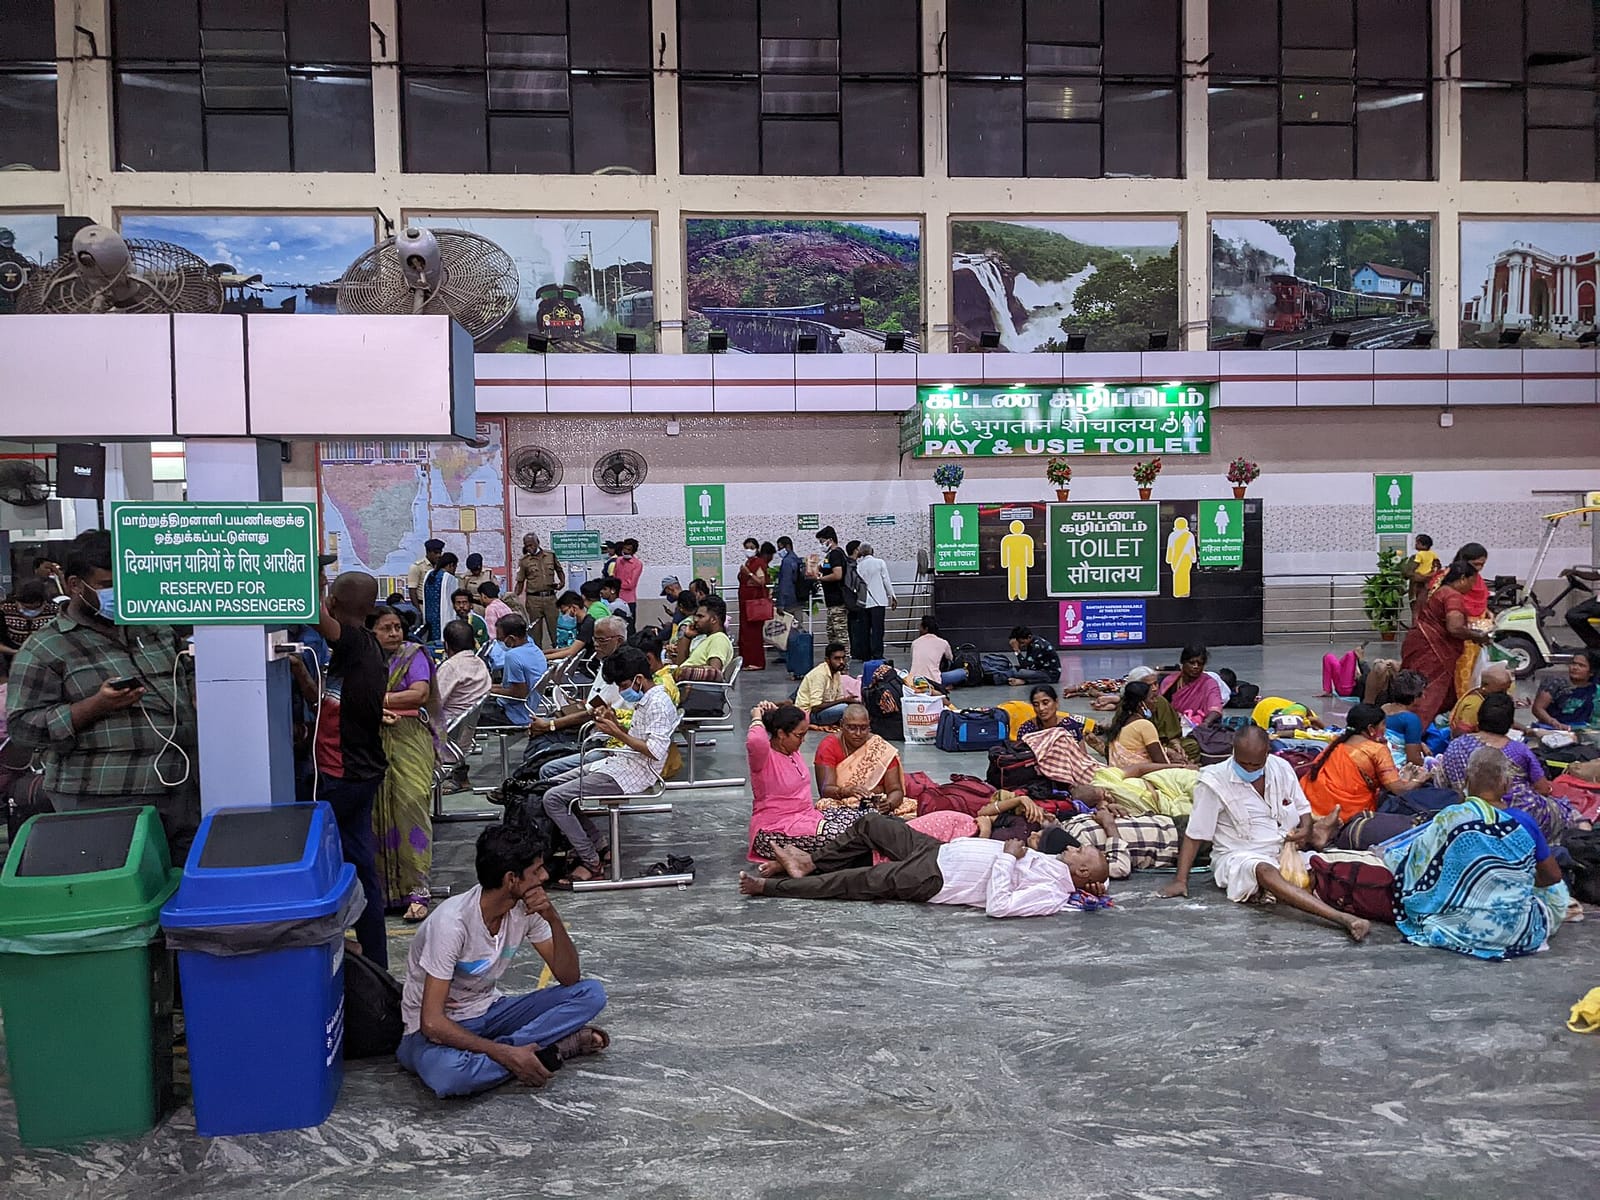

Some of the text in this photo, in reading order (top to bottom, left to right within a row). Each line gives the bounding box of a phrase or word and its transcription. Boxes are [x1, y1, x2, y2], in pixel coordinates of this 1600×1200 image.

[925, 387, 1205, 413] கட்டண கழிப்பிடம்
[971, 420, 1050, 439] भुगतान
[925, 437, 1202, 454] PAY & USE TOILET
[121, 513, 305, 528] மாற்றுத்திறனாளி பயணிகளுக்கு
[1071, 510, 1136, 521] கட்டண
[1059, 520, 1148, 536] கழிப்பிடம்
[1066, 538, 1144, 558] TOILET
[125, 548, 306, 574] दिव्यांगजन यात्रियों के लिए आरक्षित
[1067, 560, 1144, 585] सौचालय
[160, 582, 265, 595] RESERVED FOR
[127, 599, 306, 614] DIVYANGJAN PASSENGERS
